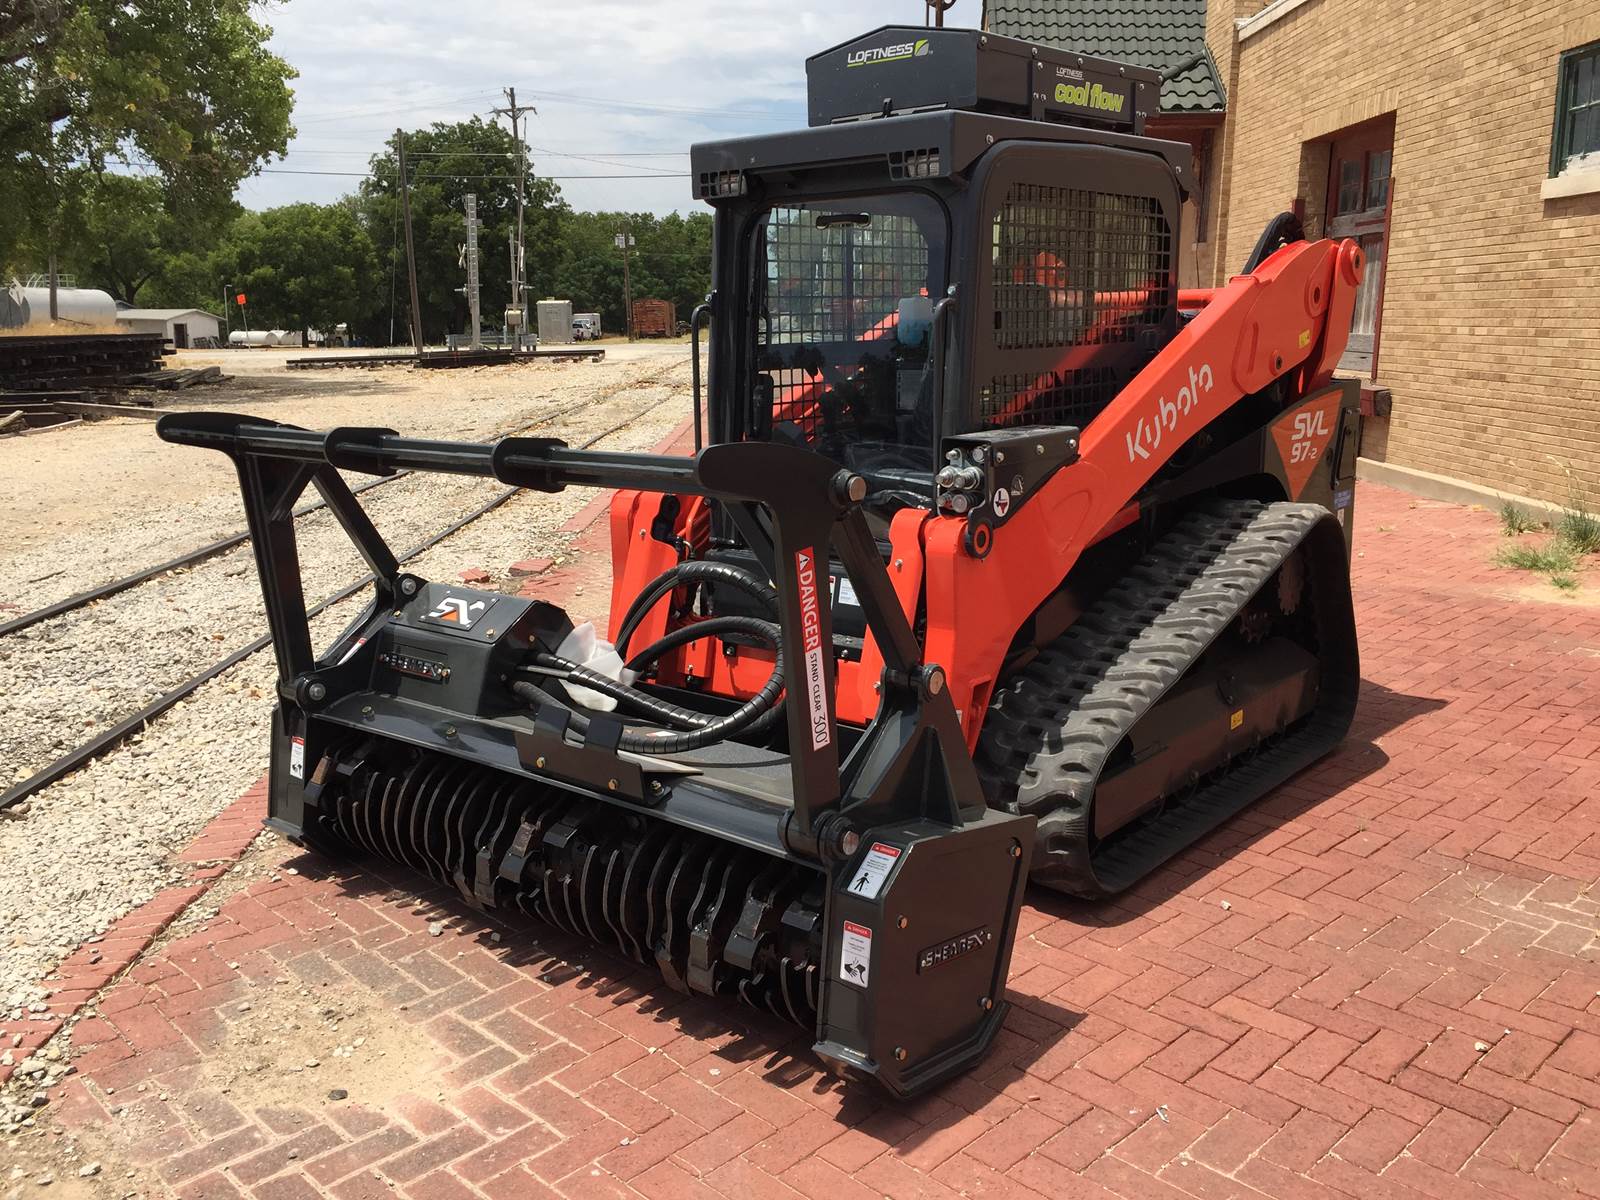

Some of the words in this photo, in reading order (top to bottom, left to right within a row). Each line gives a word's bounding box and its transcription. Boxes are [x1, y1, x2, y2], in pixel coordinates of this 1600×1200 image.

[847, 42, 914, 64] LOFTNESS
[1056, 67, 1084, 79] LOFTNESS
[1055, 82, 1090, 107] cool
[1089, 84, 1125, 112] flow
[1126, 363, 1213, 463] Kubota
[1291, 410, 1328, 440] SVL
[800, 570, 819, 651] DANGER
[810, 652, 819, 682] STAND
[812, 684, 821, 712] CLEAR
